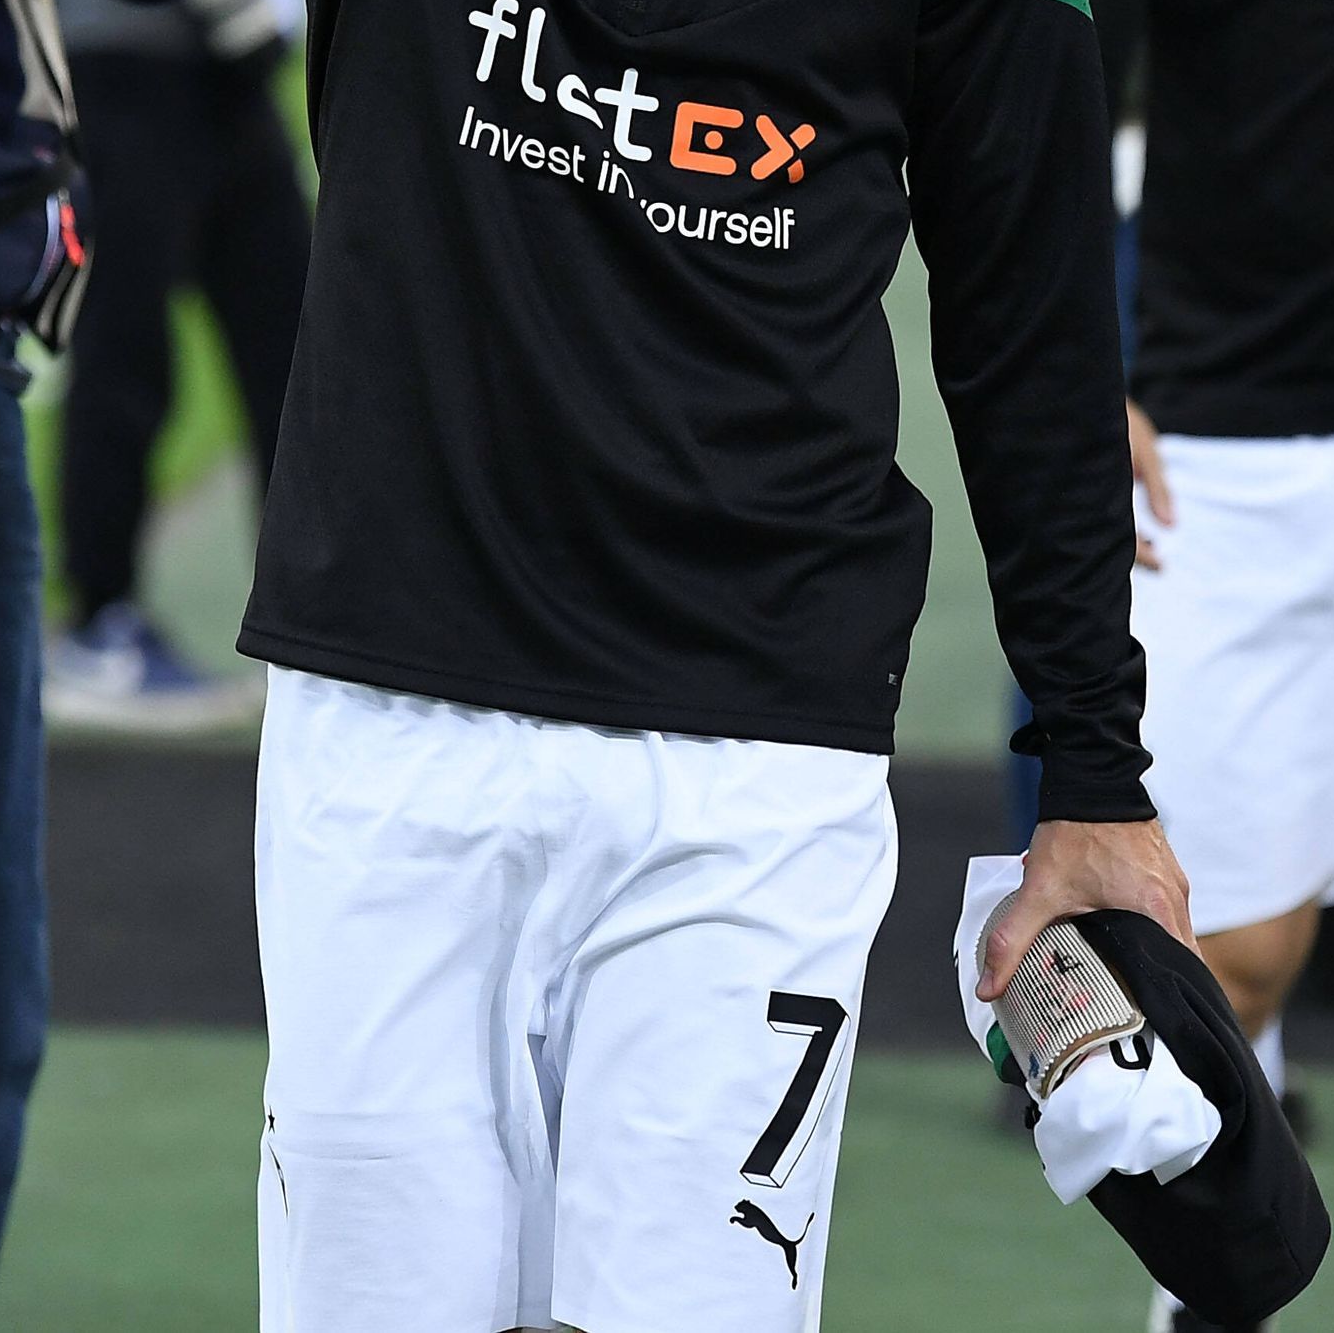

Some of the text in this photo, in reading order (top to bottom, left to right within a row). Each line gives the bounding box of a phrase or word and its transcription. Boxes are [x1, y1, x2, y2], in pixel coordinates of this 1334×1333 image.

[458, 105, 586, 183] Invest
[639, 198, 796, 250] ourself
[739, 990, 852, 1189] 7
